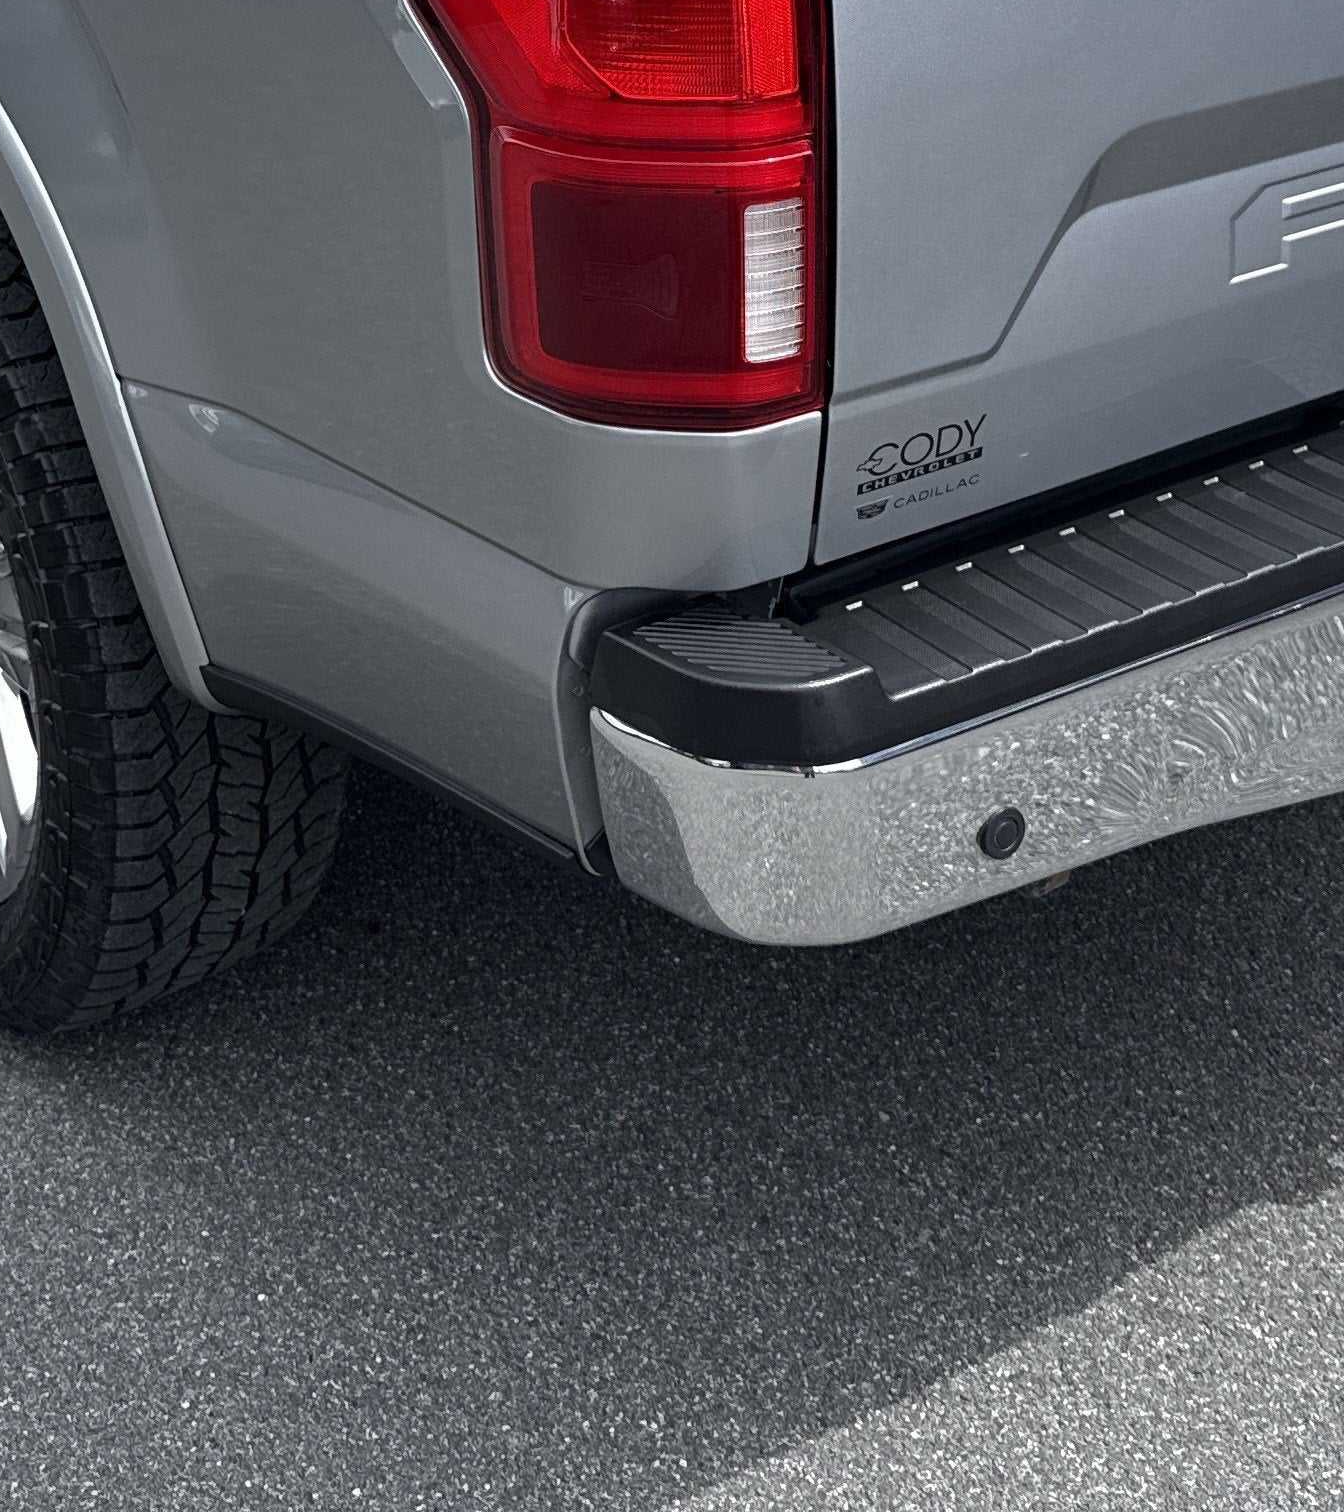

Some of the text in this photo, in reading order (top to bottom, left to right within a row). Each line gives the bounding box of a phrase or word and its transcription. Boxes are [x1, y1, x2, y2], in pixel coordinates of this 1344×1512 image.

[856, 414, 987, 477] CODY
[859, 447, 981, 494] CHEVROLET
[893, 473, 979, 508] CADILLAC
